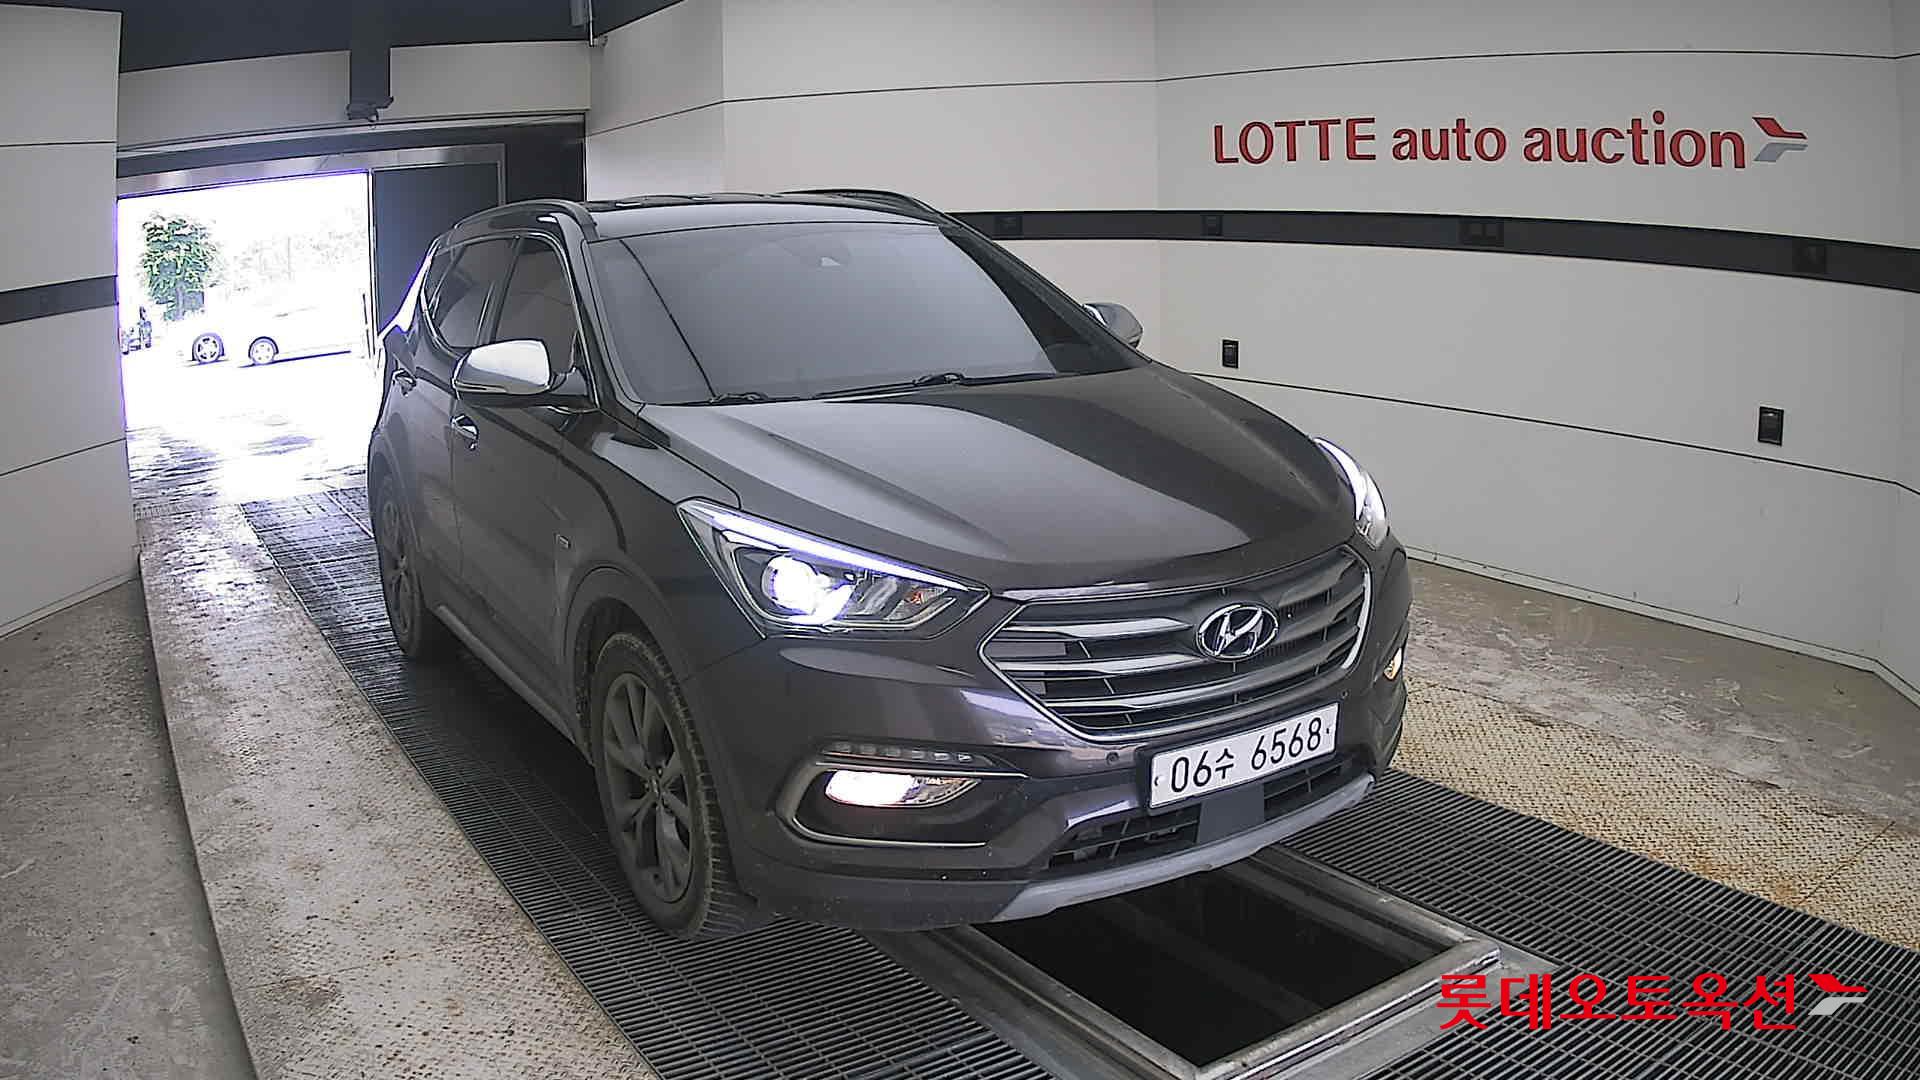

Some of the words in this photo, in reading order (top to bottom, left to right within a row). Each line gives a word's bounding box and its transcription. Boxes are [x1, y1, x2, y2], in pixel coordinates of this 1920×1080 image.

[1213, 117, 1377, 164] LOTTE
[1392, 118, 1507, 163] auto
[1523, 110, 1746, 169] auction
[1170, 748, 1235, 793] 06수
[1250, 717, 1322, 771] 6568
